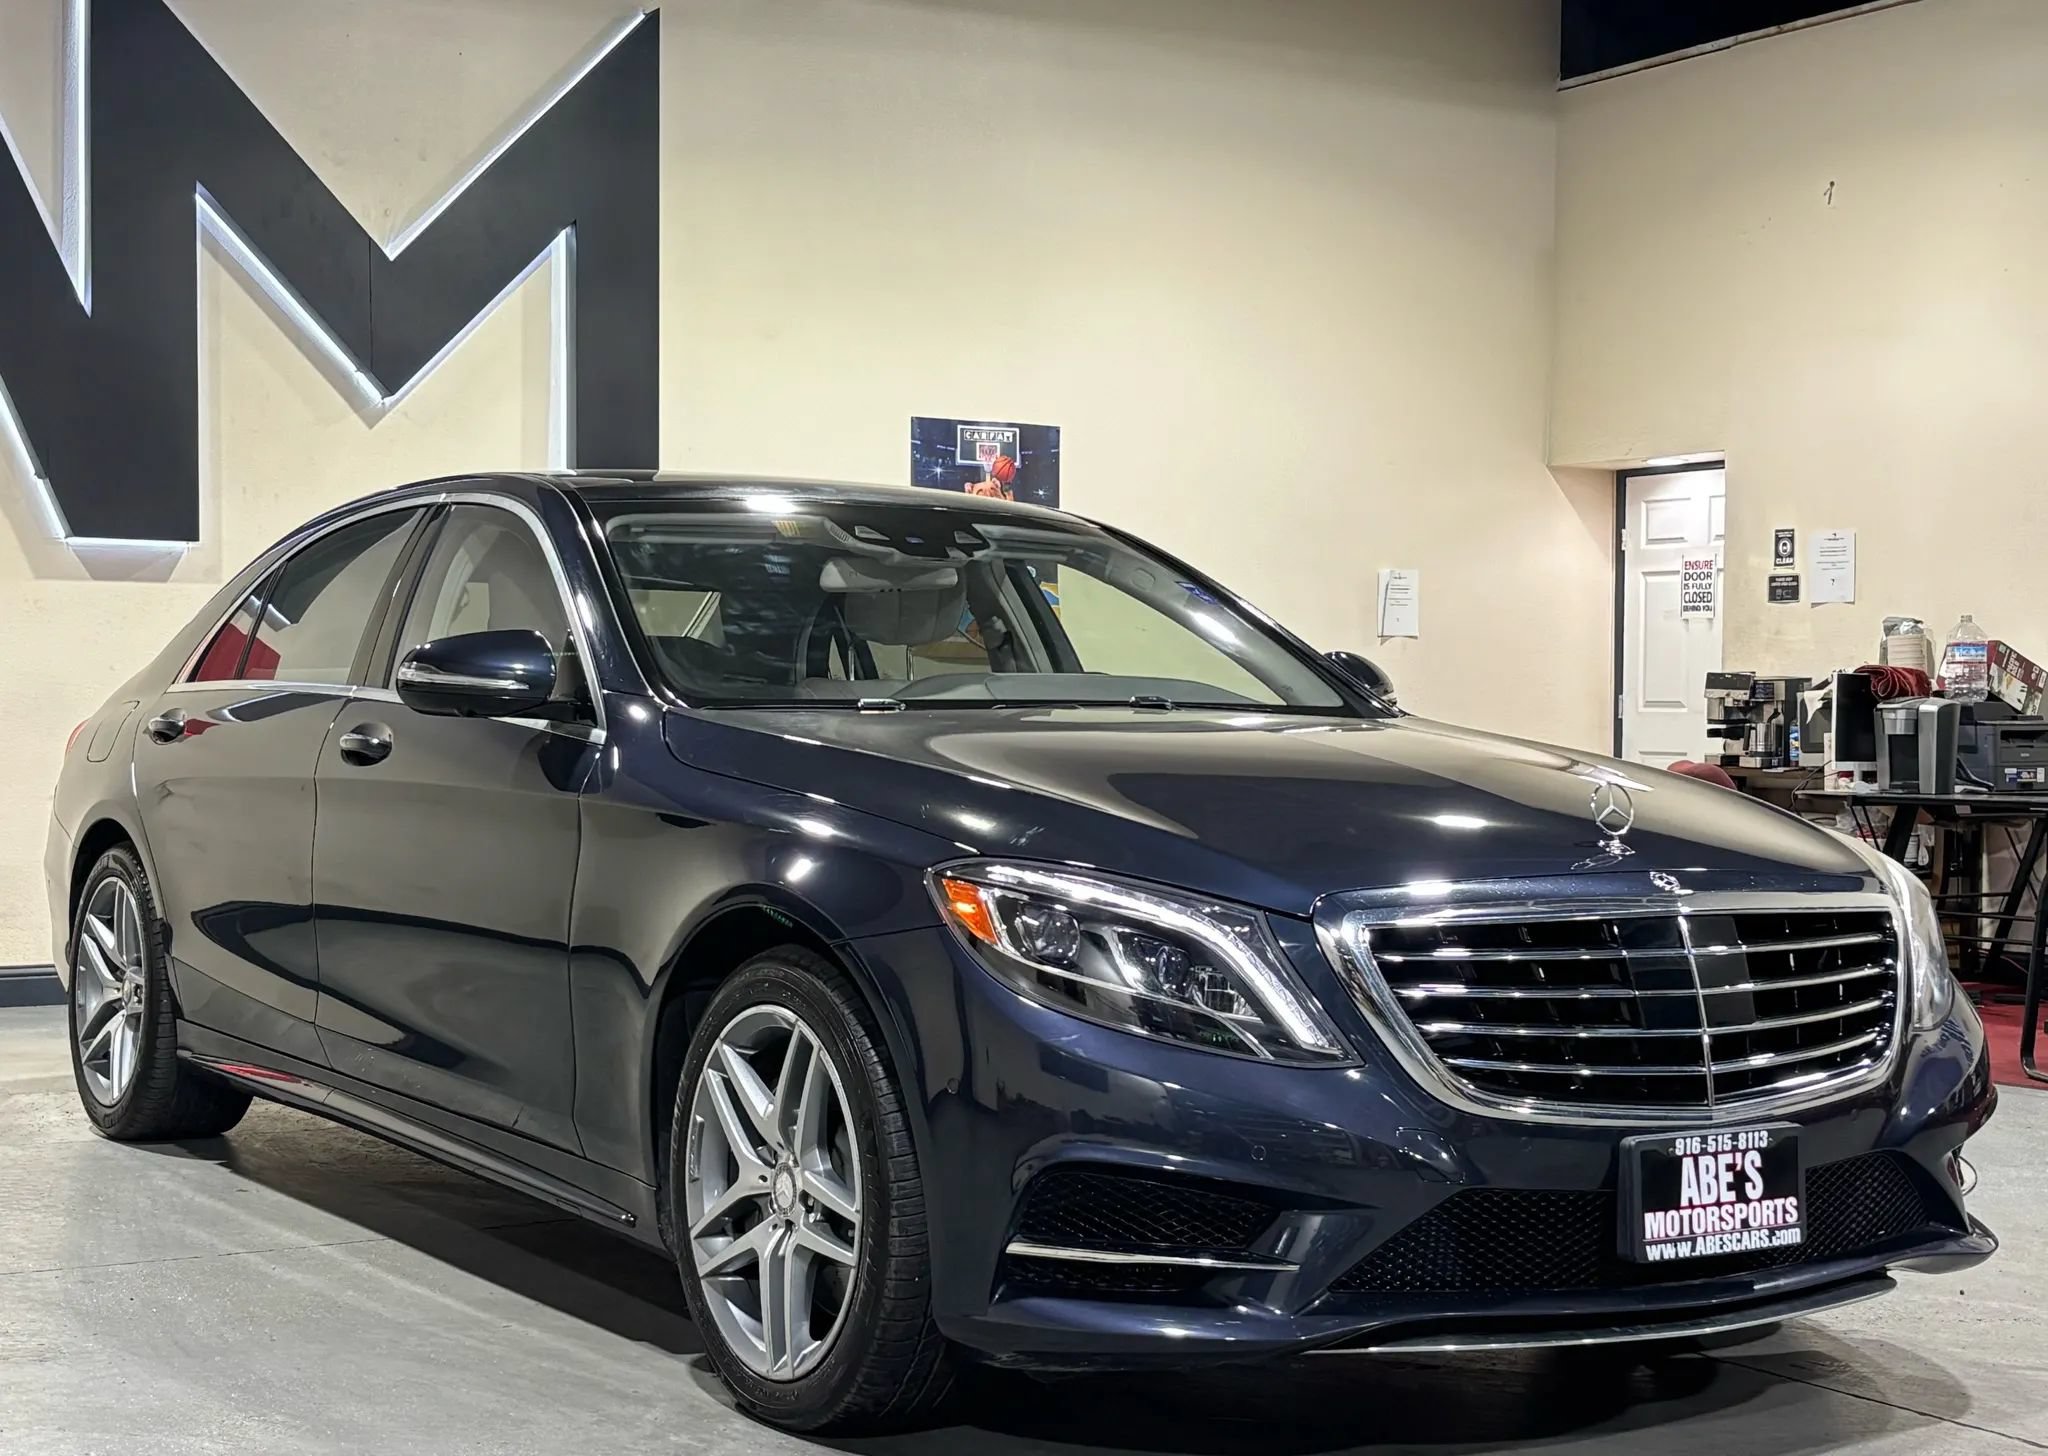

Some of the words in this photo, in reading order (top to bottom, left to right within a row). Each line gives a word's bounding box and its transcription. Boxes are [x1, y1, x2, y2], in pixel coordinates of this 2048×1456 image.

[1684, 559, 1713, 570] ENSURE
[1684, 571, 1712, 581] DOOR
[1692, 582, 1712, 590] FULLY
[1684, 591, 1712, 604] CLOSED
[1683, 604, 1701, 612] BEHIND
[1702, 604, 1712, 612] YOU
[1675, 1131, 1768, 1156] 916-515-8113
[1680, 1150, 1764, 1208] ABE'S
[1644, 1196, 1798, 1240] MOTORSPORTS
